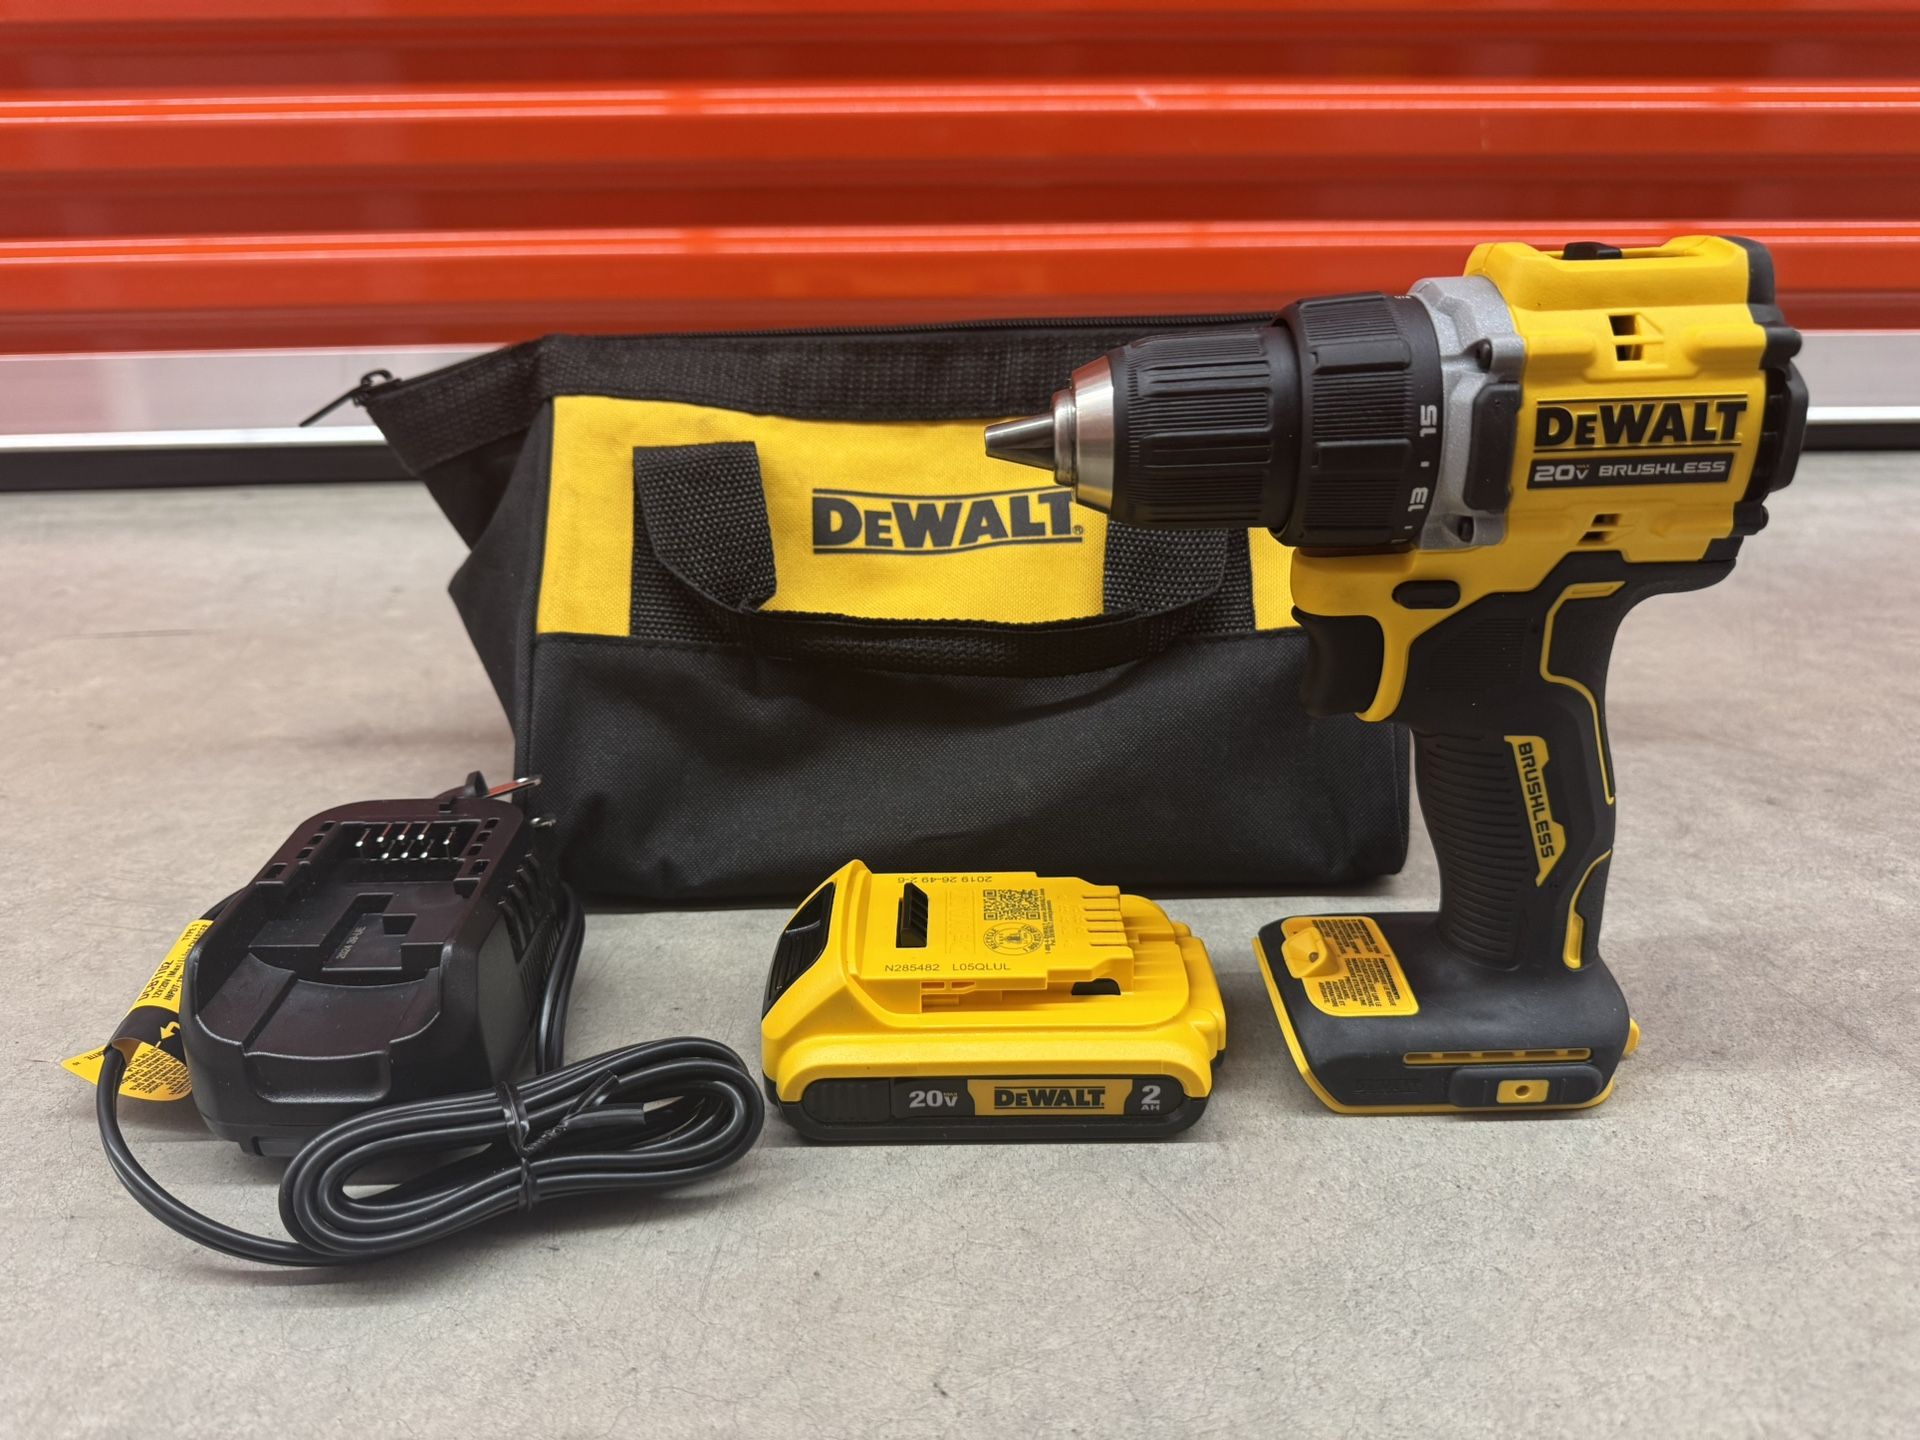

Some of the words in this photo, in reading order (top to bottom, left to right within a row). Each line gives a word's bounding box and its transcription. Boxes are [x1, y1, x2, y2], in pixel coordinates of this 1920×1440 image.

[1420, 404, 1438, 437] 15
[1534, 400, 1748, 446] DEWALT
[1534, 465, 1589, 482] 20V
[1598, 461, 1727, 477] BRUSHLESS
[1408, 487, 1428, 512] 13
[1518, 742, 1555, 859] BRUSHLESS
[884, 964, 941, 972] N285482
[909, 1089, 958, 1108] 20V
[994, 1088, 1105, 1106] DEWALT
[1141, 1084, 1161, 1104] 2
